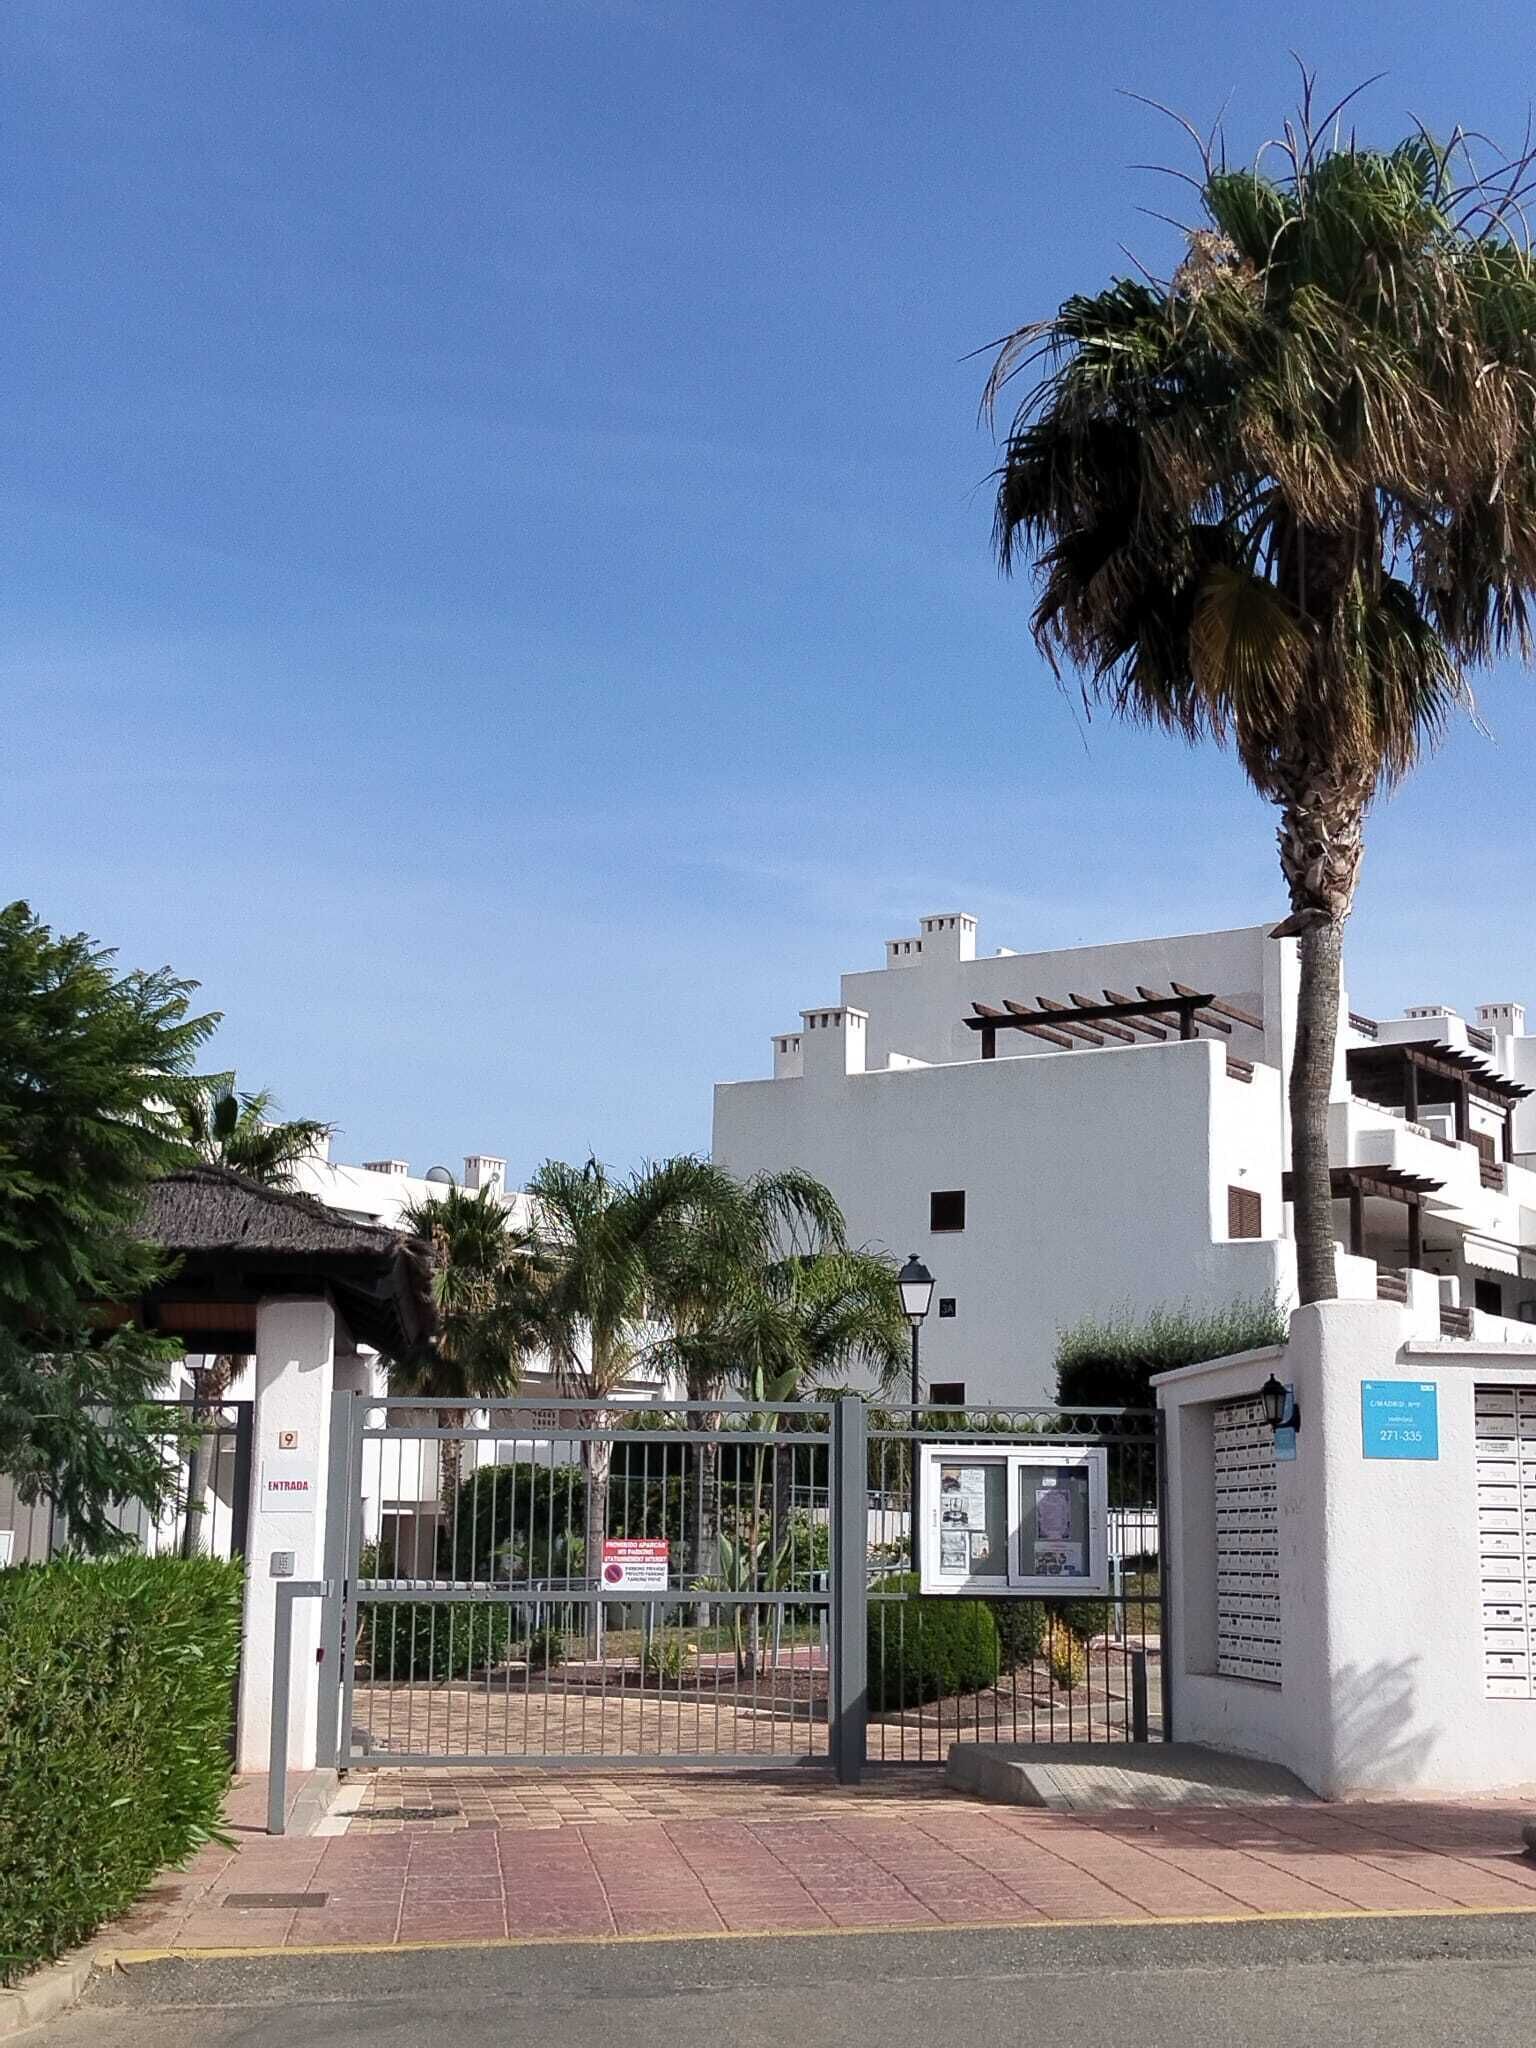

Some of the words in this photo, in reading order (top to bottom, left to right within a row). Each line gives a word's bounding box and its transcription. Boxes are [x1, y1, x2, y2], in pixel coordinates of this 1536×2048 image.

[285, 1433, 294, 1446] 9
[1380, 1430, 1422, 1442] 271-335
[268, 1481, 309, 1491] ENTRADA
